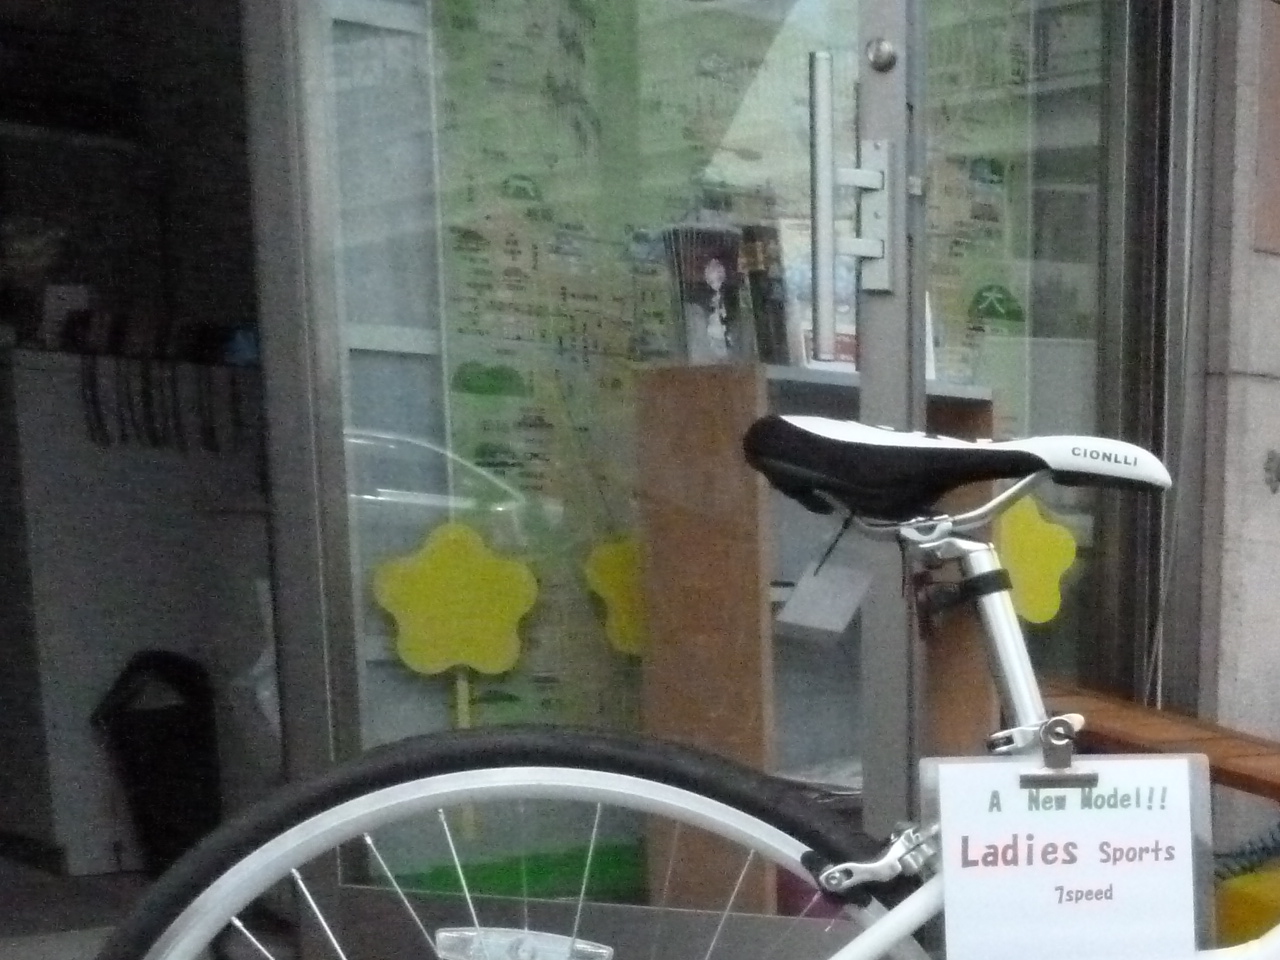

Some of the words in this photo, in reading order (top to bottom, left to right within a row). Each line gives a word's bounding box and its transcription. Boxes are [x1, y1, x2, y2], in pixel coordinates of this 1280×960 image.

[1071, 446, 1138, 467] CIONLLI
[988, 790, 1002, 812] A
[1027, 786, 1067, 811] New
[1080, 786, 1168, 810] Model!!
[961, 833, 1079, 868] Ladies
[1098, 840, 1176, 866] Sports
[1055, 884, 1114, 904] 7speed
